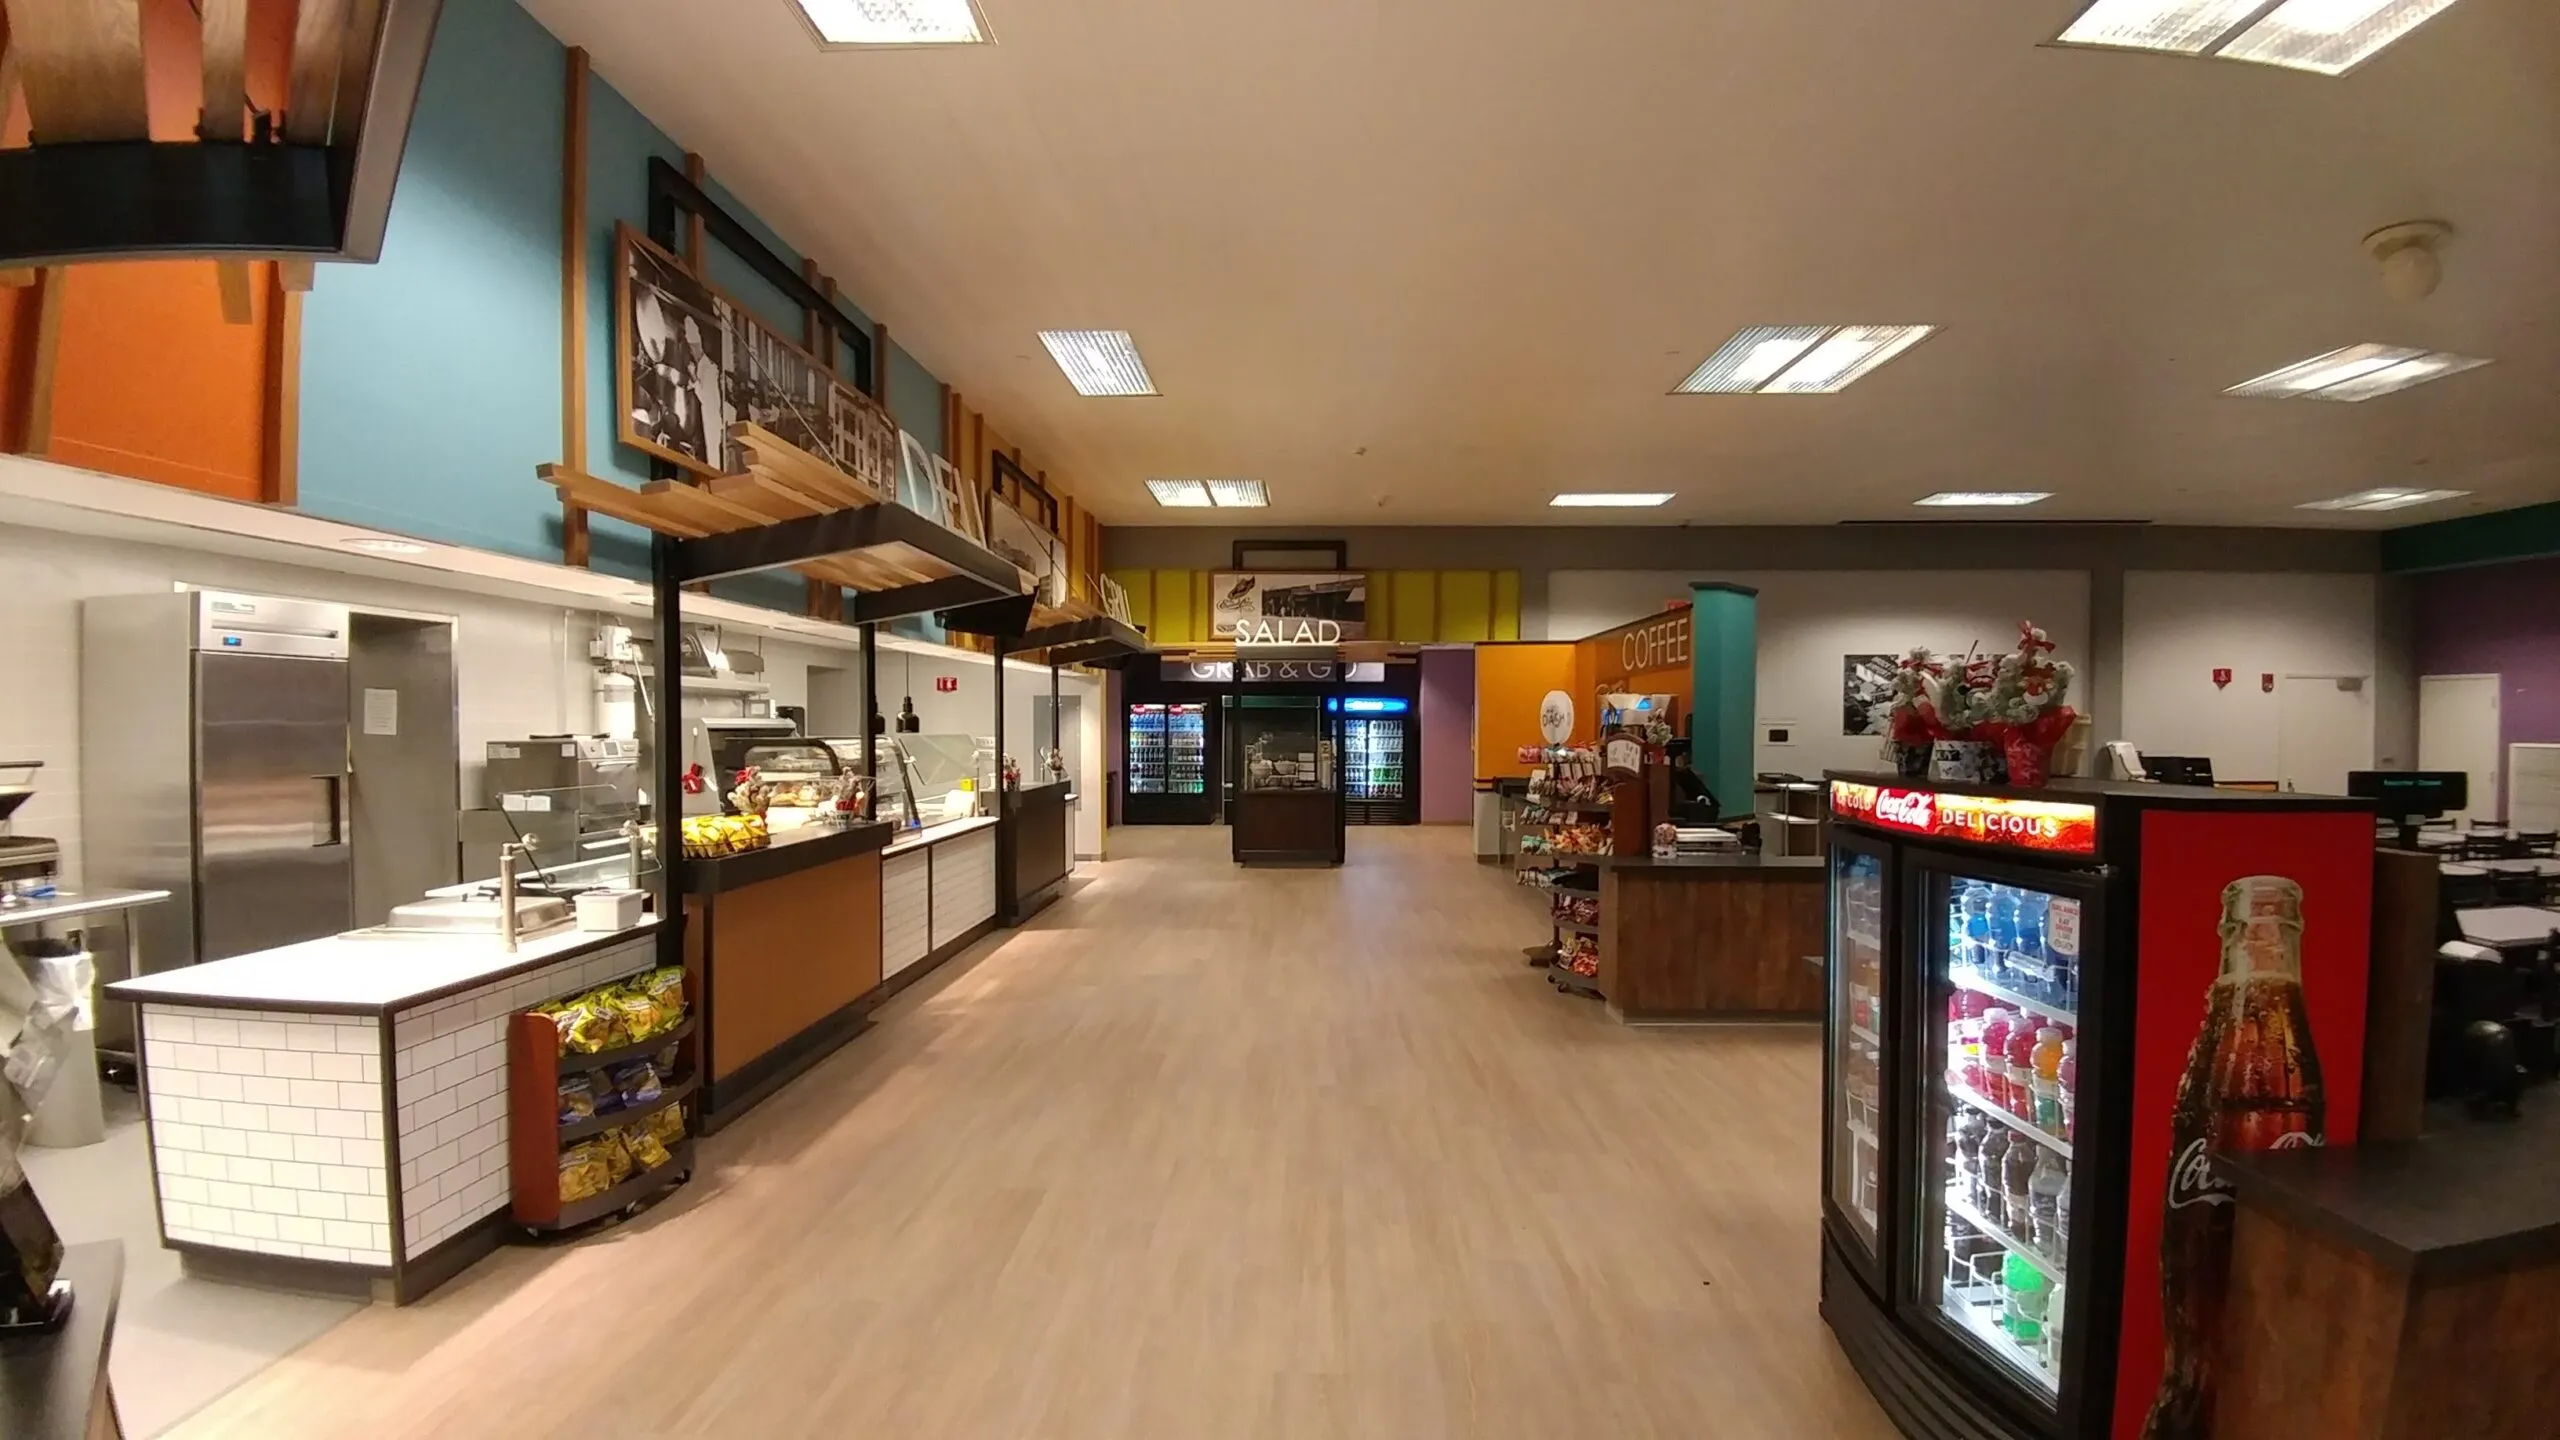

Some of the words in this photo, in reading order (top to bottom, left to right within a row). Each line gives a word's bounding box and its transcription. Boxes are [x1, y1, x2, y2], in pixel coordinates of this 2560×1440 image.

[898, 427, 987, 551] DELI
[1235, 618, 1341, 645] SALAD
[1622, 617, 1688, 671] COFFEE
[1279, 661, 1299, 679] &
[1876, 789, 1934, 830] Coca-Cola
[1942, 808, 2058, 838] DELICIOUS
